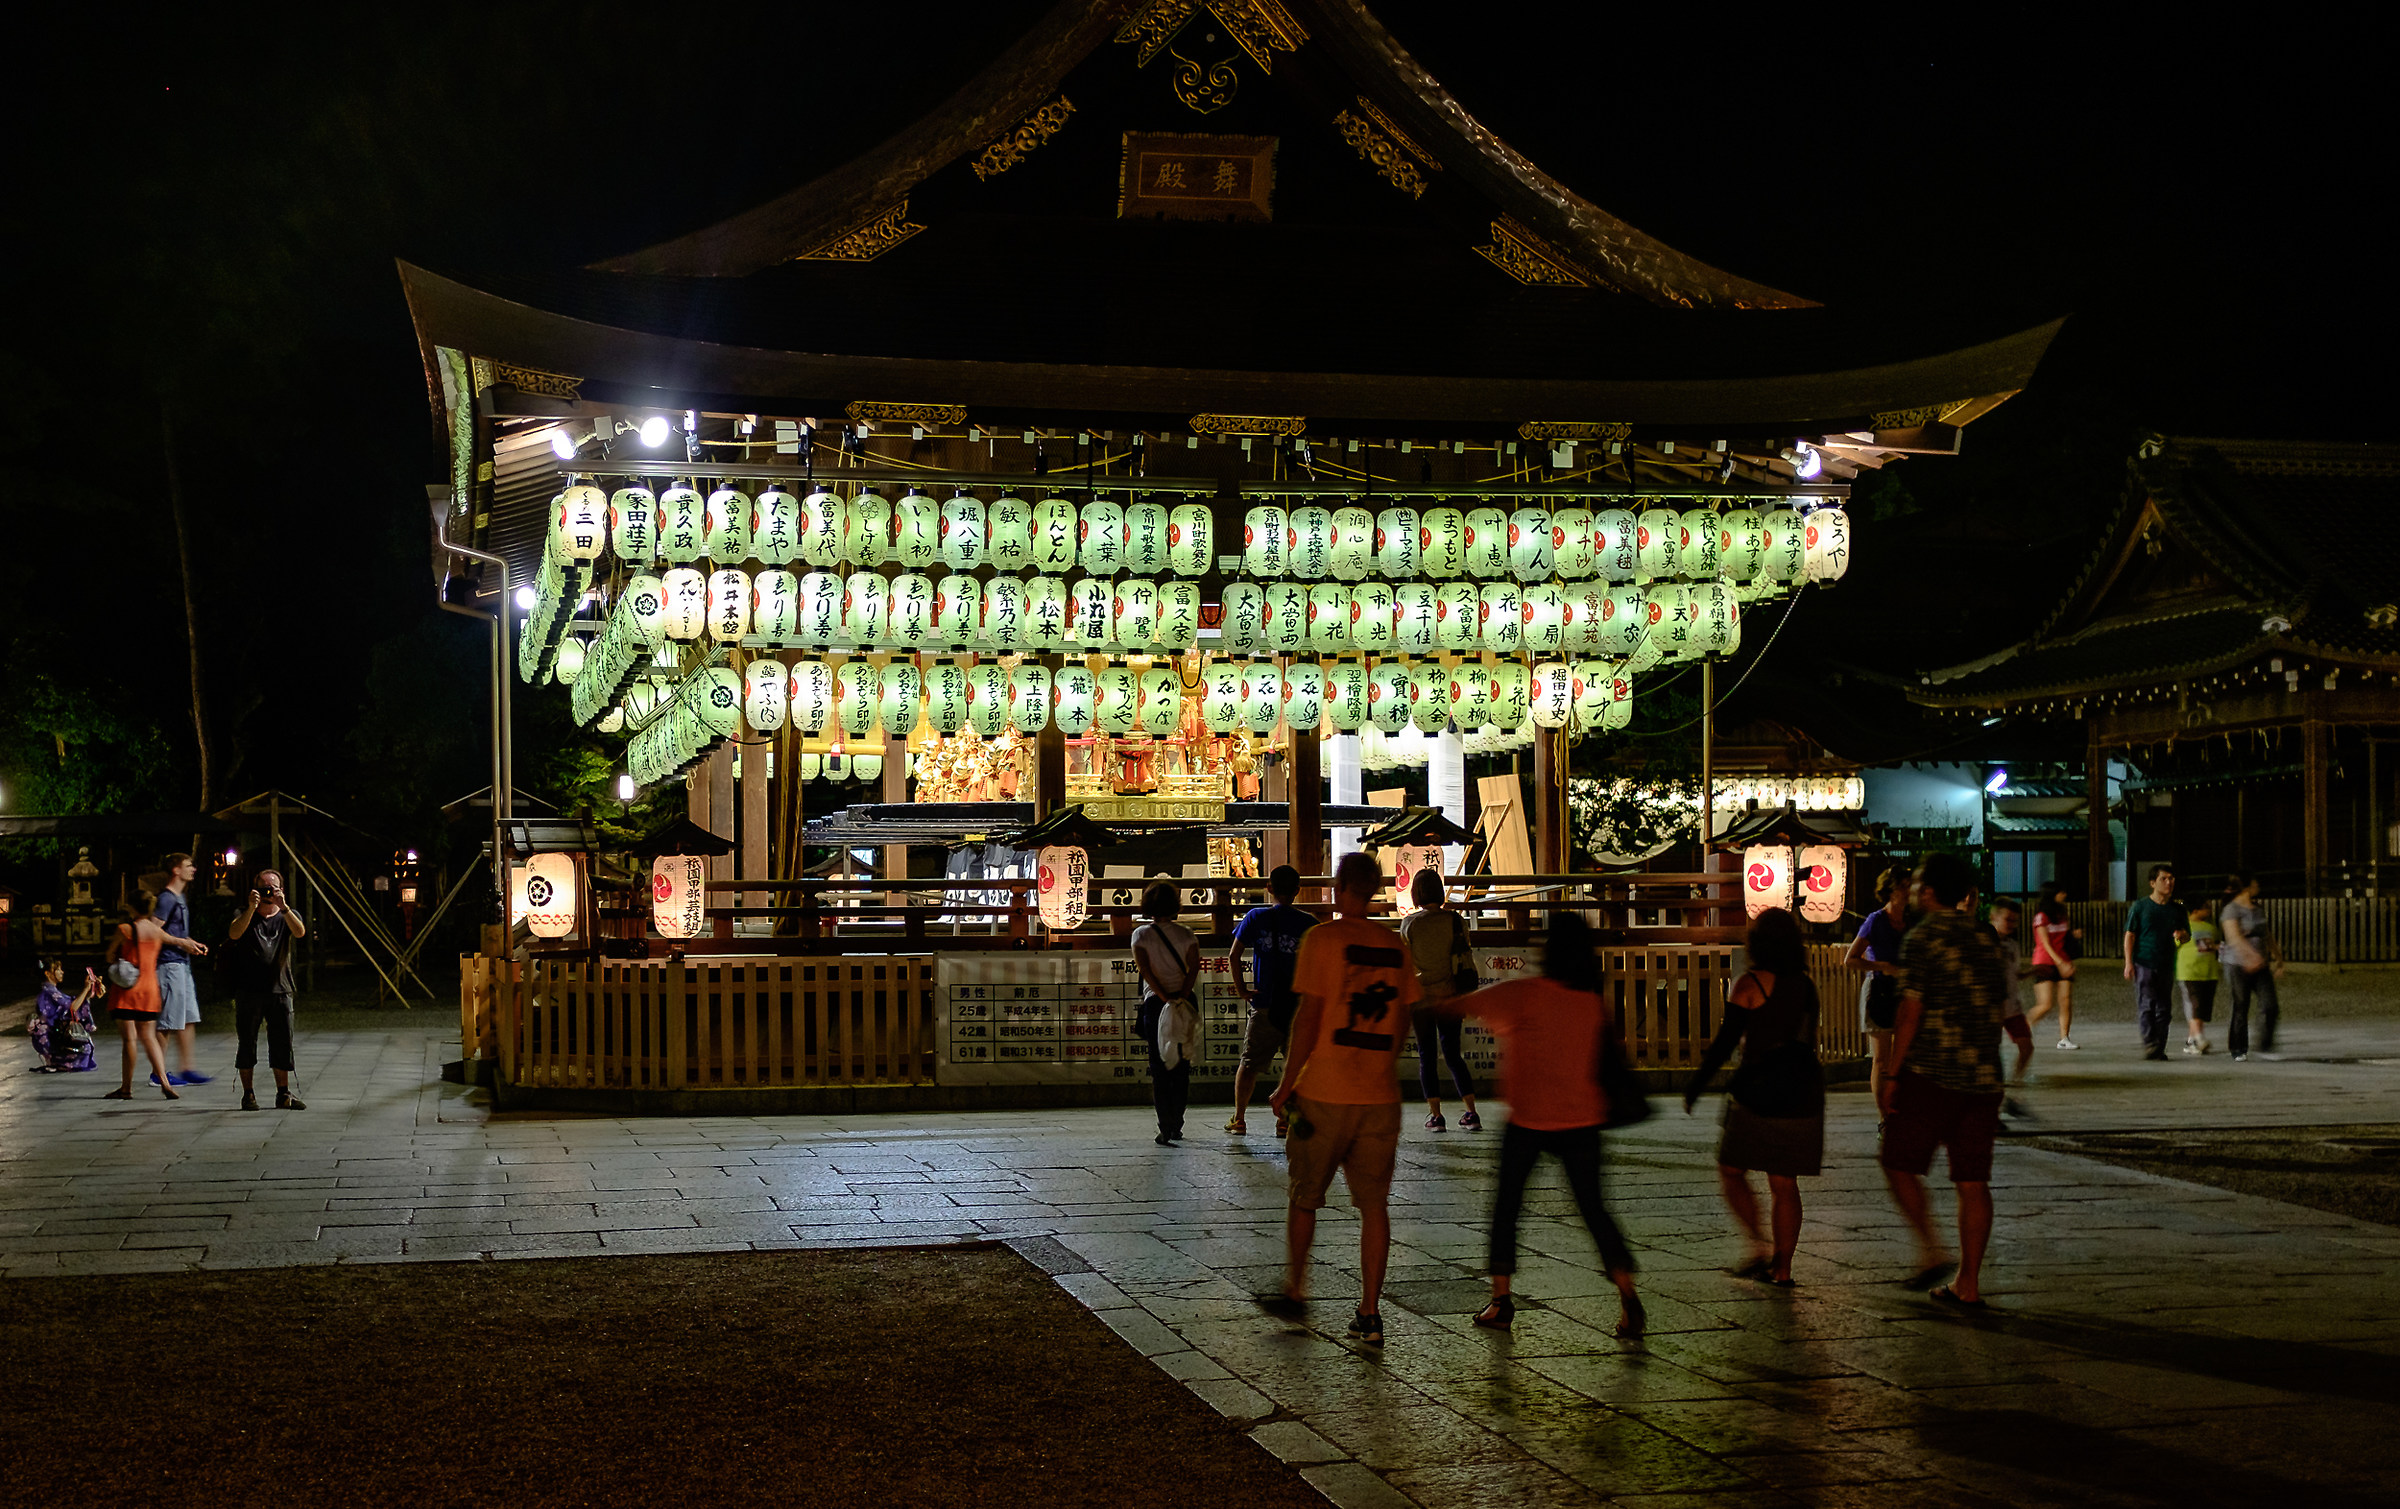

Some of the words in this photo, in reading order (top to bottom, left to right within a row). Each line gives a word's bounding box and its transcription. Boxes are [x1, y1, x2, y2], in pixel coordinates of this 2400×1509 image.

[575, 513, 595, 549] 三田
[625, 492, 648, 554] 家田荘子
[674, 494, 695, 550] 貴久政
[722, 495, 742, 555] 富美祐
[766, 497, 789, 557] たまや
[816, 498, 837, 558] 富美代
[911, 504, 932, 558] いし初
[958, 507, 979, 560] 堀八重
[1047, 504, 1067, 563] ほんとん
[1096, 507, 1118, 563] ふく葉
[1139, 508, 1156, 564] 宮川町歌舞会
[1190, 508, 1207, 569] 宮川町歌舞会
[1442, 512, 1459, 570] まつもと
[1484, 513, 1503, 567] 叶恵
[1529, 513, 1550, 570] えん
[1743, 516, 1761, 574] 桂あす香
[1784, 516, 1802, 575] 桂あす香
[1827, 513, 1847, 569] とろや
[996, 582, 1018, 644] 繁乃家
[1036, 602, 1061, 640] 松本
[1086, 584, 1106, 639] 小丸屋
[1171, 585, 1192, 643] 富久家
[1324, 592, 1345, 640] 小花
[1368, 589, 1387, 641] 市光
[1414, 590, 1432, 645] 豆千佳
[1455, 587, 1474, 642] 久富美
[1542, 590, 1563, 644] 小扇
[1582, 591, 1600, 644] 富美苑
[1023, 670, 1043, 726] 井上隆保
[1508, 686, 1526, 725] 花斗
[1550, 669, 1566, 722] 堀田芳史
[958, 1005, 987, 1017] 25歳
[1003, 1005, 1051, 1017] 平成4年生
[1069, 1004, 1116, 1016] 平成3年生
[1213, 1002, 1239, 1015] 19歳
[958, 1026, 987, 1038] 42歳
[1000, 1026, 1055, 1037] 昭和50年生
[1065, 1025, 1120, 1036] 昭和49年生
[1212, 1023, 1239, 1035] 33歳
[959, 1046, 987, 1058] 61歳
[1000, 1046, 1055, 1058] 昭和31年生
[1065, 1045, 1121, 1056] 昭和30年生
[1213, 1044, 1240, 1056] 37歳
